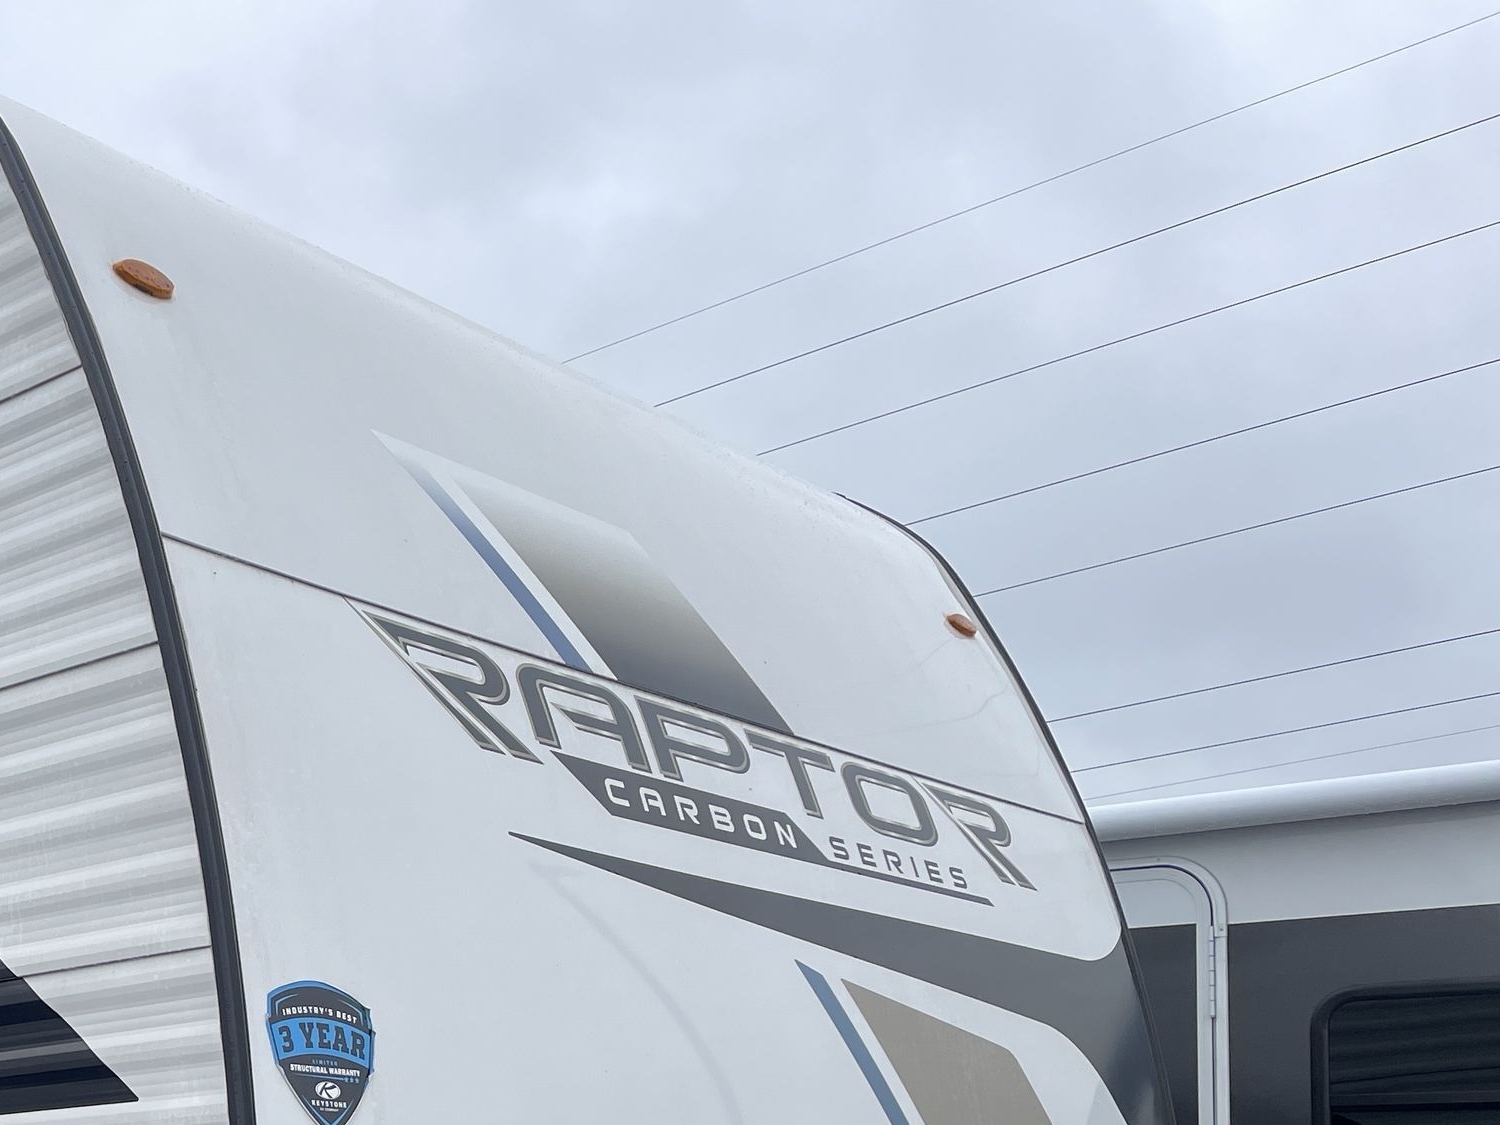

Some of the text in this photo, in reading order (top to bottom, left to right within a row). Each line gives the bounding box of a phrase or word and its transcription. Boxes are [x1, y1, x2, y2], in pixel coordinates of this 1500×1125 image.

[361, 609, 1038, 891] RAPTOR
[603, 777, 969, 890] CARBON SERIES
[282, 1005, 358, 1024] INDUSTRY'S BEST
[278, 1021, 366, 1060] 3 YEAR
[290, 1063, 361, 1077] STRUCTURAL WARRANTY
[311, 1099, 348, 1108] KEYSTONE
